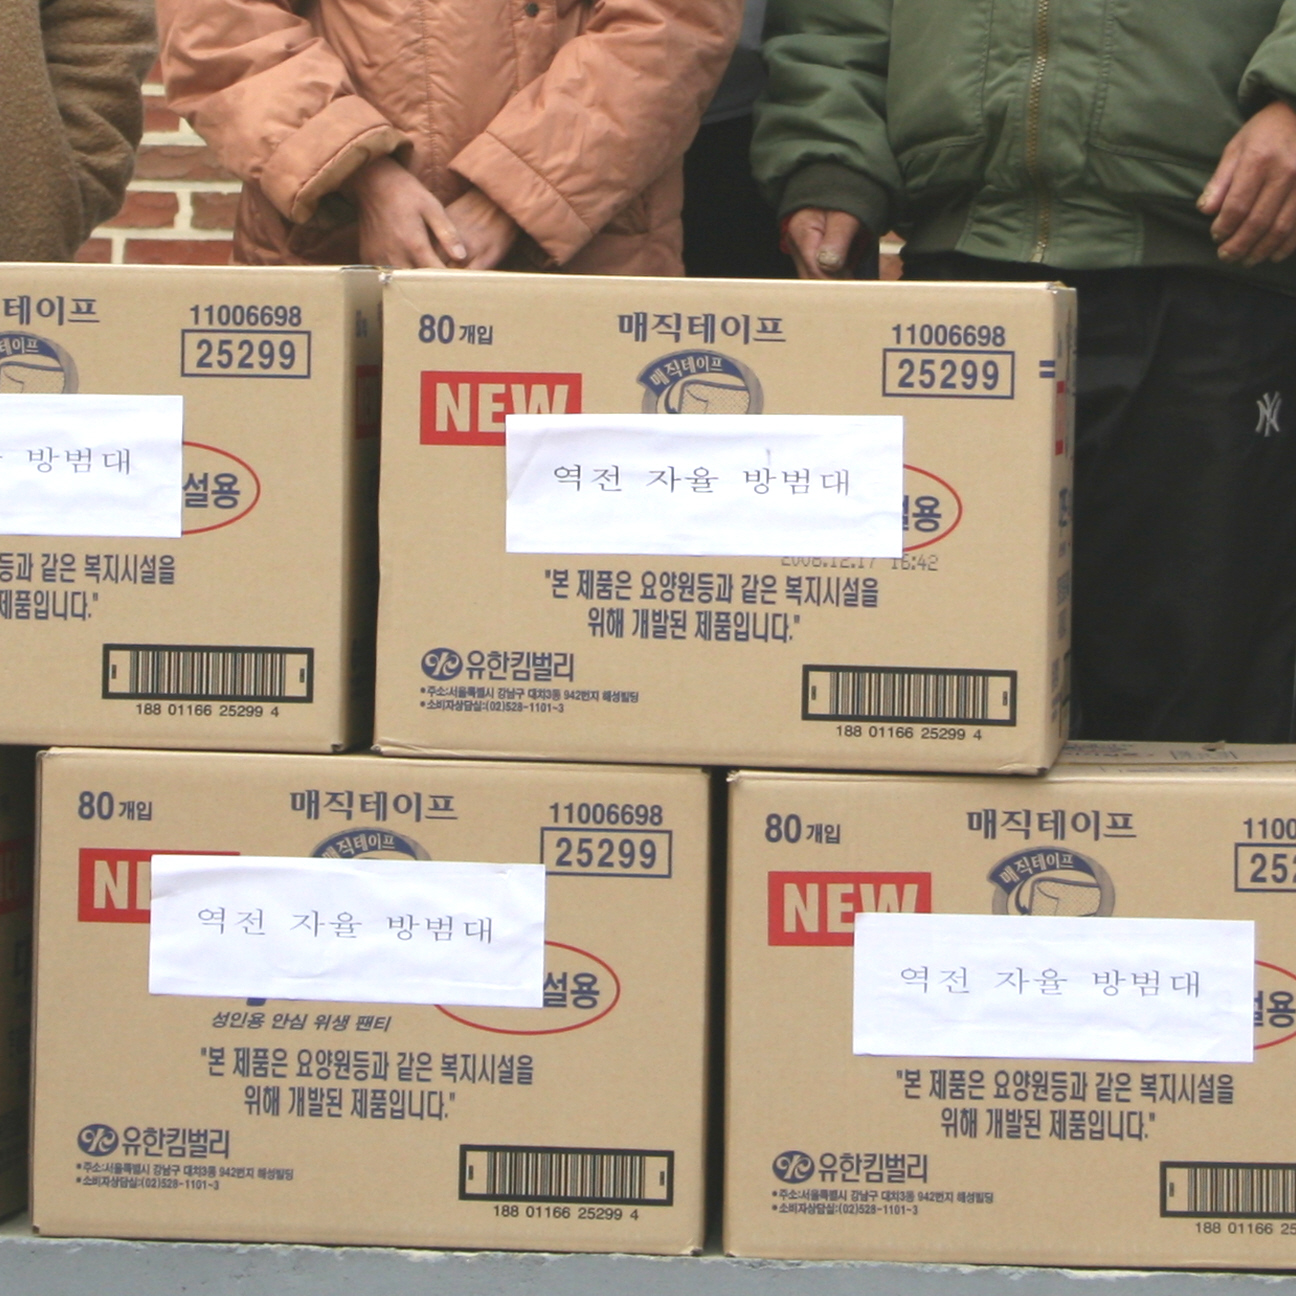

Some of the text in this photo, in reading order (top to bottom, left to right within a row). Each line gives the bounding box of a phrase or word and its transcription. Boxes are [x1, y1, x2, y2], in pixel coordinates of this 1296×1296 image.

[190, 305, 301, 327] 11006698
[618, 312, 786, 345] 매직테이프
[892, 324, 1005, 347] 11006698
[196, 339, 295, 370] 25299
[647, 355, 724, 389] 매직테이프
[895, 358, 999, 394] 25299
[1255, 391, 1282, 437] NY
[27, 447, 129, 475] 방범대
[554, 464, 848, 495] 역전 자율 방범대
[41, 553, 76, 583] 같은
[84, 554, 175, 585] 복지시설을
[577, 570, 632, 600] 제품은
[640, 571, 733, 604] 요양원등과
[741, 575, 777, 605] 같은
[785, 576, 878, 608] 복지시설을
[588, 607, 624, 638] 위해
[632, 609, 686, 640] 개발된
[466, 650, 574, 682] 유한킴벌리
[137, 703, 279, 717] 188 01166 25299 4
[837, 725, 982, 740] 188 01166 25299 4
[290, 790, 458, 822] 매직테이프
[550, 802, 663, 826] 11006698
[967, 809, 1136, 841] 매직테이프
[556, 837, 656, 869] 25299
[999, 852, 1075, 883] 매직테이프
[198, 907, 491, 944] 역전 자율 방범대
[901, 966, 1199, 998] 역전 자율 방범대
[212, 1012, 392, 1032] 성인용 안심 위생 팬티
[233, 1047, 288, 1078] 제품은
[296, 1049, 389, 1081] 요양원등과
[397, 1052, 432, 1082] 같은
[441, 1053, 533, 1085] 복지시설을
[244, 1085, 280, 1116] 위해
[288, 1087, 342, 1118] 개발된
[929, 1069, 985, 1100] 제품은
[994, 1070, 1088, 1102] 요양원등과
[1096, 1072, 1131, 1103] 같은
[1140, 1073, 1234, 1104] 복지시설을
[941, 1107, 977, 1138] 위해
[986, 1109, 1041, 1139] 개발된
[122, 1126, 229, 1159] 유한킴벌리
[818, 1153, 927, 1183] 유한킴벌리
[494, 1205, 638, 1220] 188 01166 25299 4
[1196, 1222, 1221, 1234] 188
[1228, 1222, 1273, 1234] 01166
